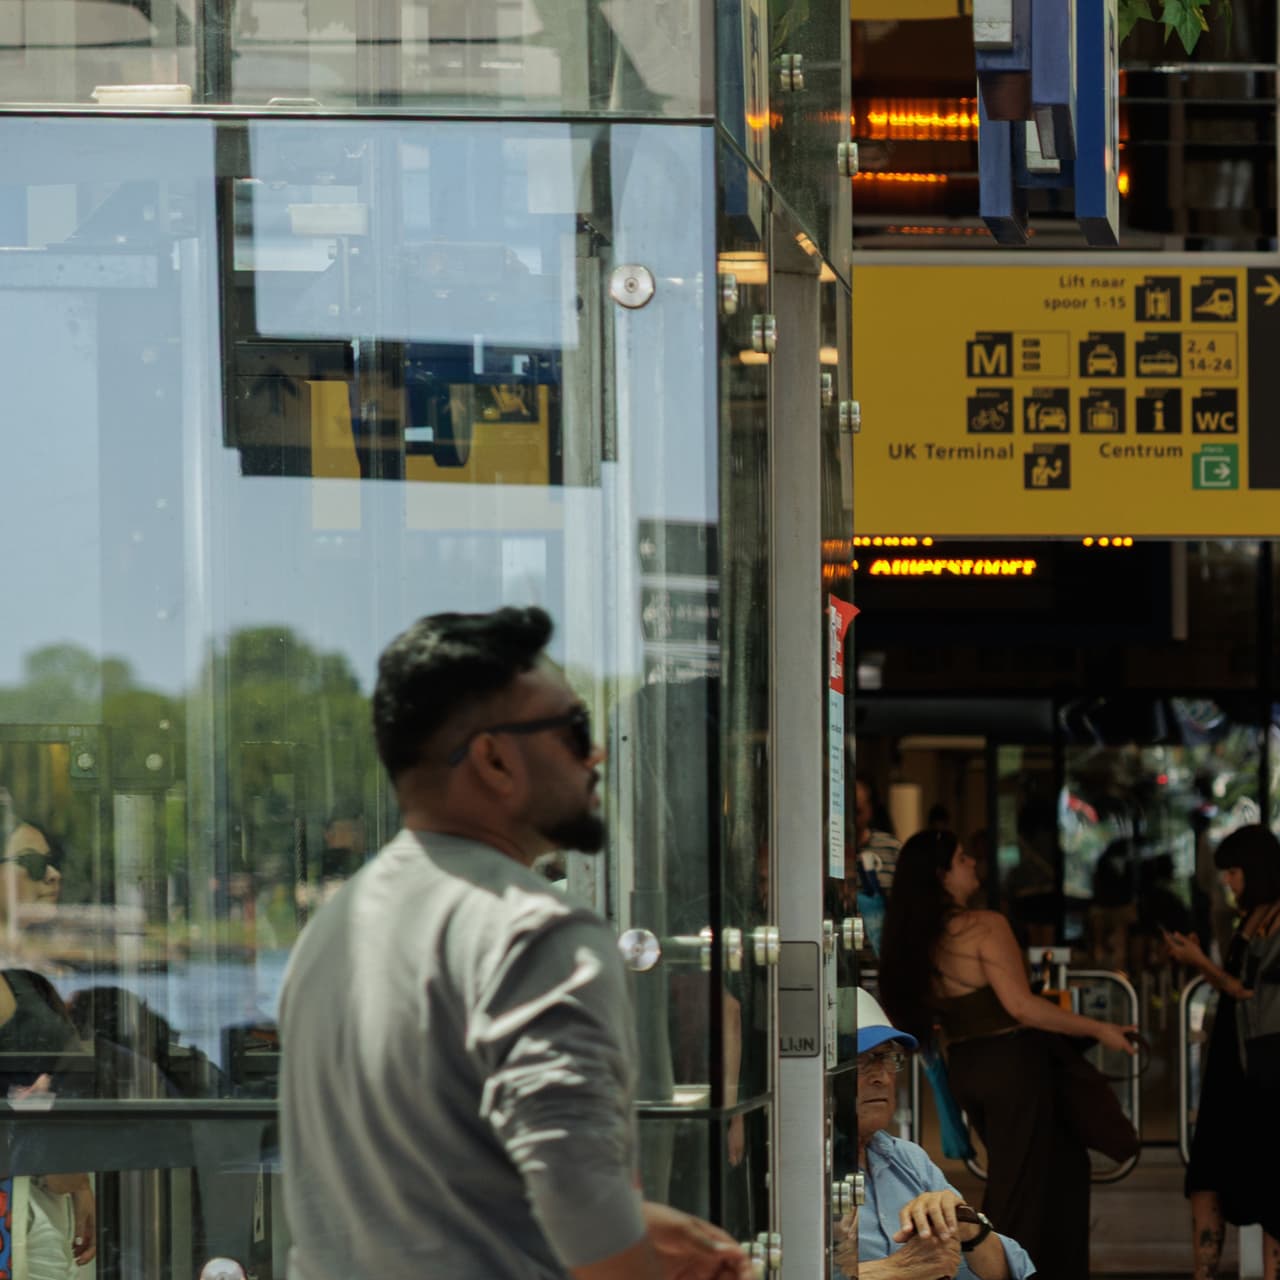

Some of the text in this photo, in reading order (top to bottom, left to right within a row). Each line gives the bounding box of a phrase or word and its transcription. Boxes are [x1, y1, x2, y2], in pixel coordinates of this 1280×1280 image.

[1059, 275, 1126, 289] Lift naar
[1043, 296, 1127, 311] spoor 1-15
[1188, 358, 1233, 372] 14-24
[1195, 411, 1235, 431] WC
[888, 442, 1014, 460] UK Terminal
[1099, 442, 1184, 459] Centrum
